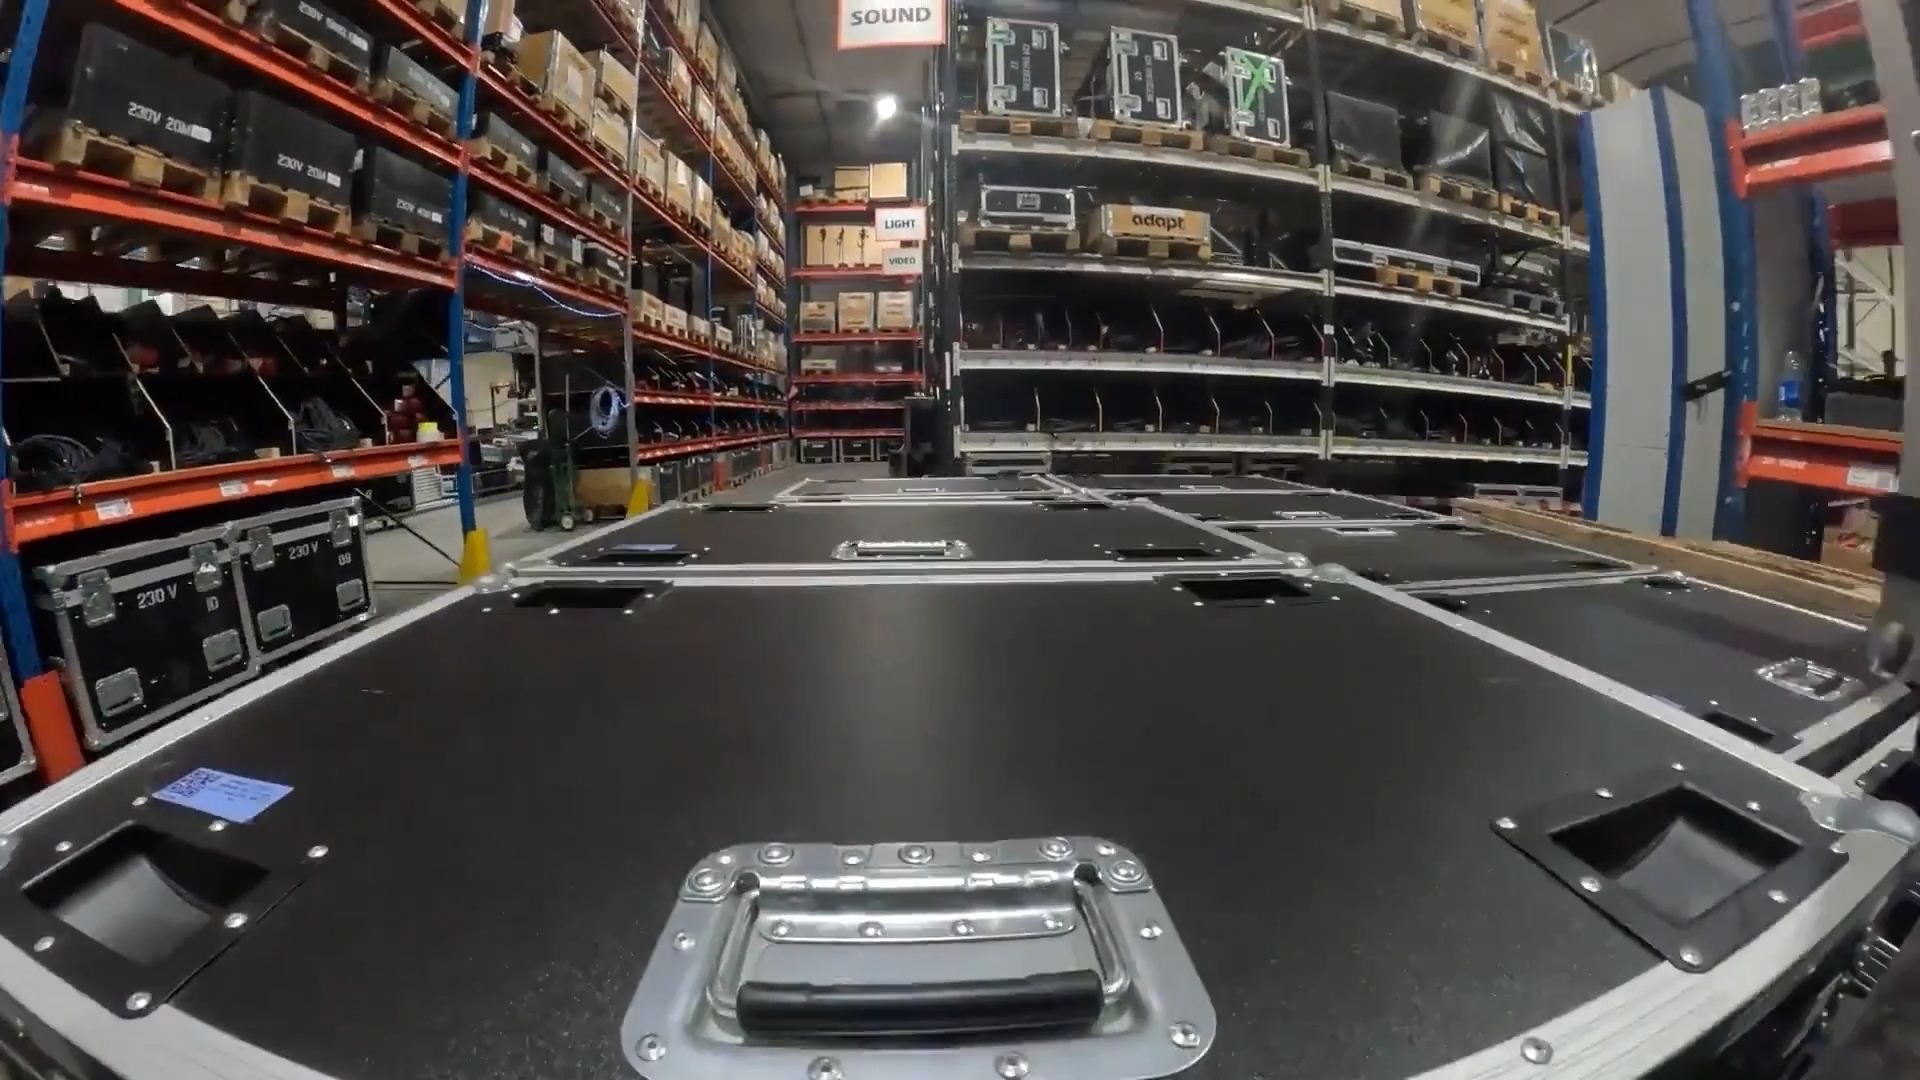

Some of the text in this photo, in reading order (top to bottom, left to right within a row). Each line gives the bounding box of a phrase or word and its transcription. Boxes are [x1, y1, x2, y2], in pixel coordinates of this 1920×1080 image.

[850, 7, 932, 26] SOUND
[128, 101, 162, 125] 230V
[277, 153, 304, 172] 230V
[884, 219, 916, 229] LIGHT
[1132, 214, 1186, 232] adapt
[889, 256, 916, 265] VIDEO
[289, 540, 319, 560] 230 V
[136, 583, 177, 609] 230 V
